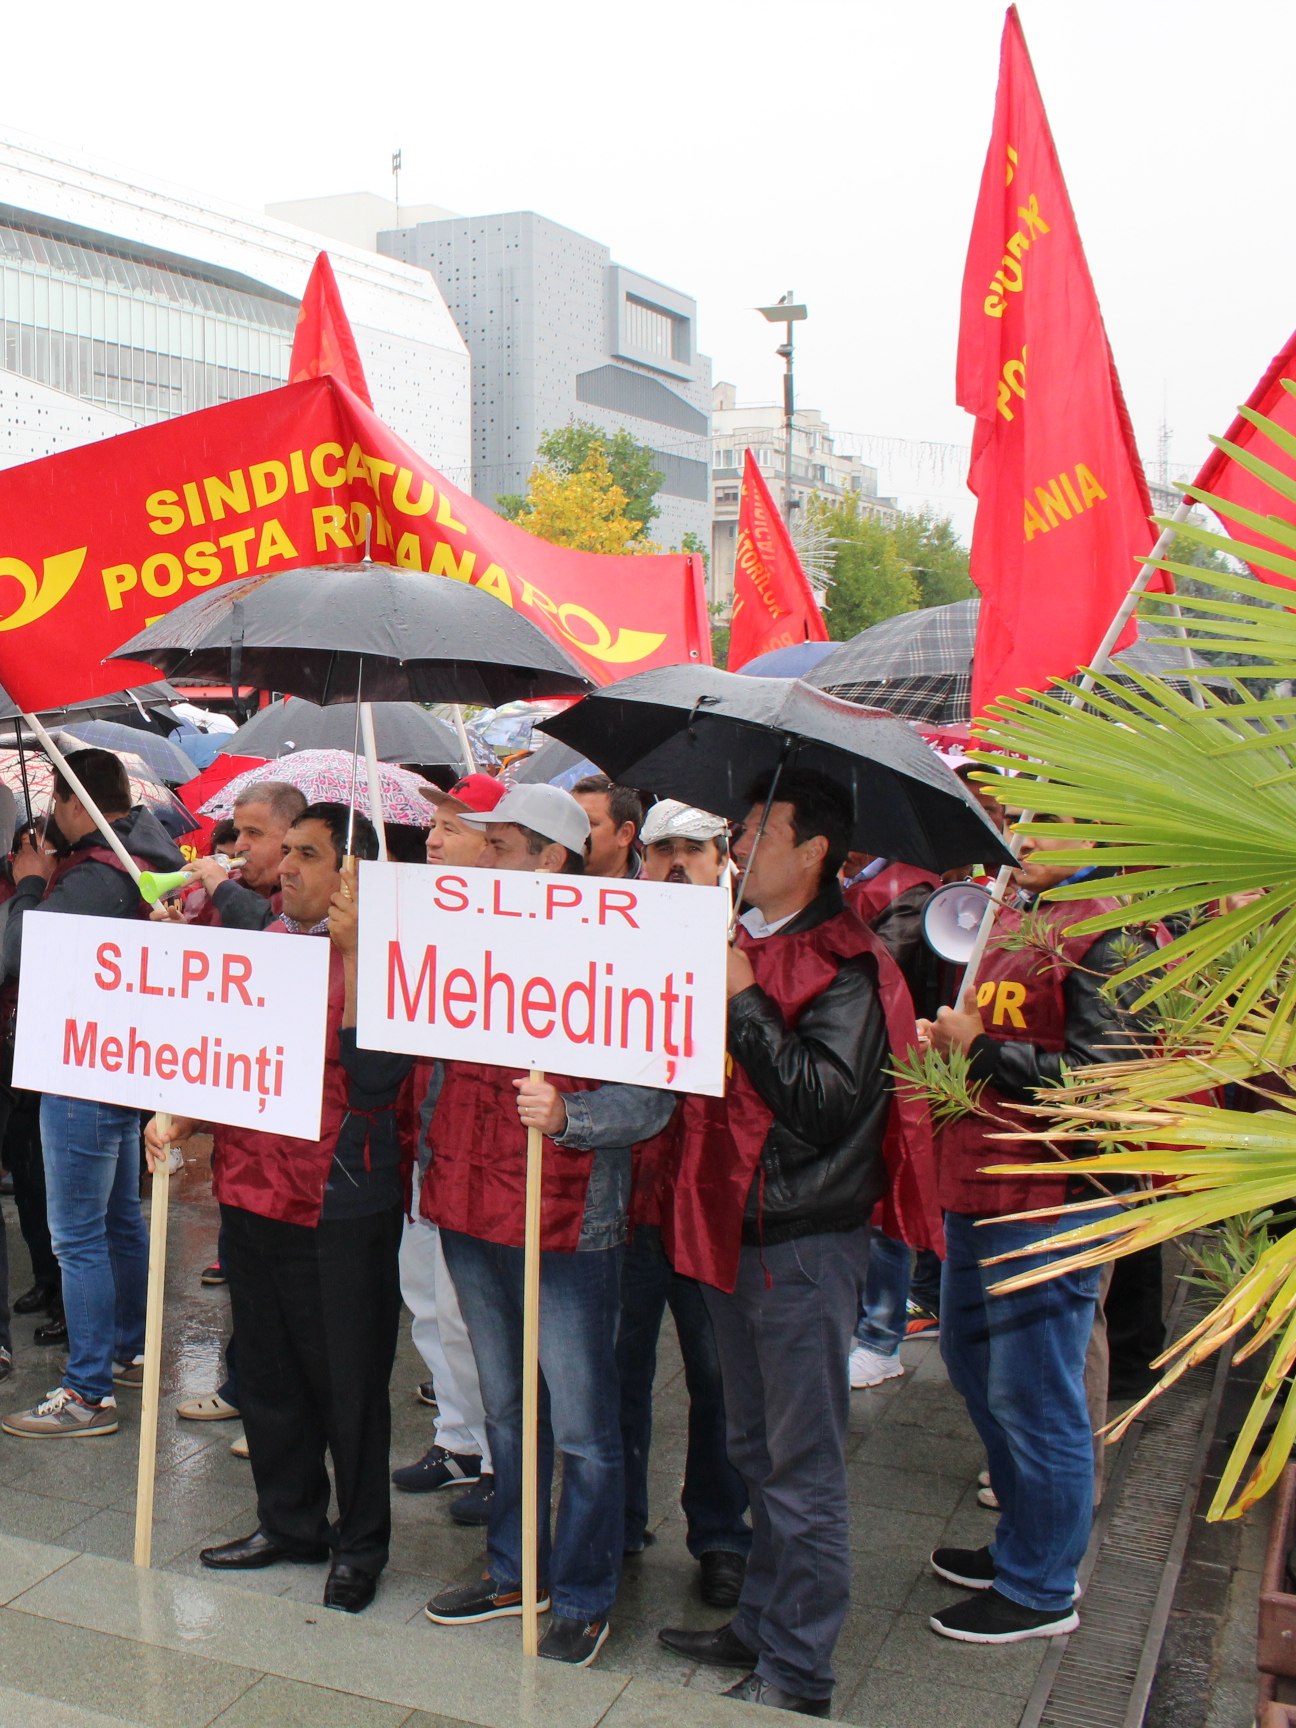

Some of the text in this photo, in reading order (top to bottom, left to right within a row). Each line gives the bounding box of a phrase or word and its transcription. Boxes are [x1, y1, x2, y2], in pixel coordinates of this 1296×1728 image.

[145, 441, 467, 536] SINDICATUL
[101, 518, 299, 611] POSTA
[179, 845, 205, 862] SL
[433, 874, 641, 930] S.L.P.R
[94, 942, 266, 1008] S.L.P.R.
[386, 940, 694, 1084] Mehedinți
[976, 980, 1027, 1029] PR
[63, 1018, 284, 1115] Mehedinți
